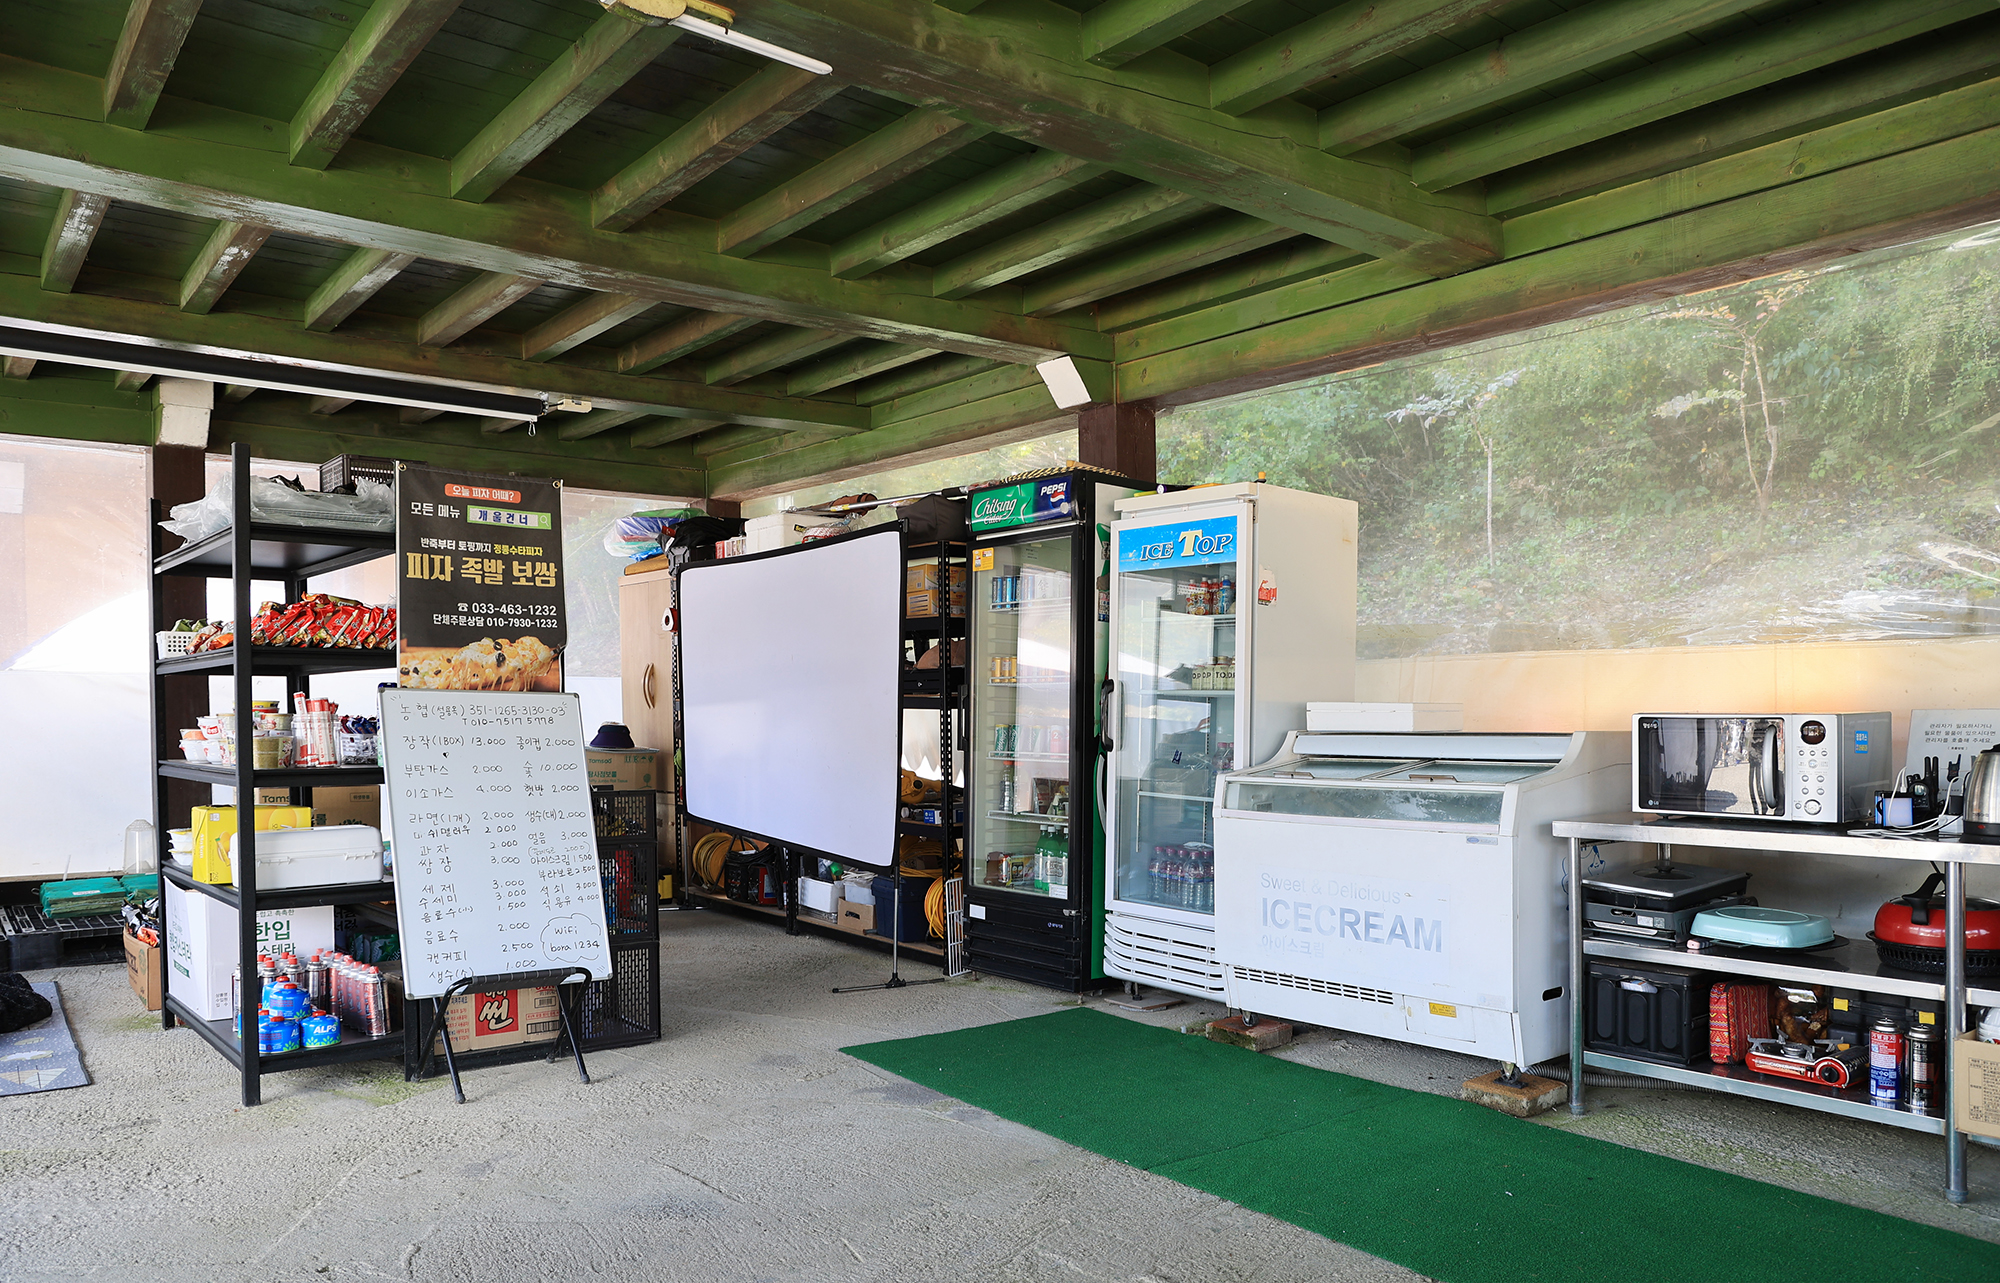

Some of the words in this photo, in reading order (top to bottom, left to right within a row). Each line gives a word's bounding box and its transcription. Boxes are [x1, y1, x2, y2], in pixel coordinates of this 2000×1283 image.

[452, 486, 470, 497] 오늘
[472, 488, 490, 499] 피자
[492, 490, 515, 502] 어때?
[1041, 482, 1067, 496] PEPSI
[411, 502, 434, 517] 모든
[438, 504, 461, 519] 메뉴
[974, 498, 1018, 520] Chilsung
[420, 537, 456, 550] 반죽부터
[458, 540, 492, 553] 토핑까지
[1140, 541, 1174, 561] ICE
[1178, 529, 1233, 557] TOP
[406, 552, 454, 582] 피자
[460, 556, 505, 586] 족발
[511, 560, 558, 588] 보쌈
[471, 603, 557, 616] 033-463-1232
[433, 614, 484, 628] 단체주문상담
[486, 618, 558, 629] 010-7930-1232
[526, 716, 555, 726] 5778
[471, 737, 506, 746] 13.000
[516, 735, 542, 751] 종이컵
[545, 738, 576, 747] 2.000
[404, 765, 450, 778] 부탄가스
[472, 765, 504, 774] 2.000
[540, 763, 578, 772] 10.000
[406, 786, 454, 798] 이소가스
[476, 785, 512, 793] 4.000
[524, 783, 544, 796] 햇반
[552, 785, 580, 793] 2.000
[481, 811, 514, 820] 2.000
[558, 810, 587, 820] 2.000
[528, 832, 546, 845] 얼음
[561, 831, 588, 840] 3.000
[491, 856, 520, 865] 3.000
[531, 854, 571, 865] 아이스크림
[574, 853, 592, 863] 1.500
[575, 865, 596, 874] 2.500
[492, 879, 525, 889] 3.000
[1261, 873, 1306, 893] Sweet
[1328, 880, 1401, 904] Delicious
[419, 893, 457, 909] 수세미
[496, 889, 527, 900] 3.000
[542, 896, 571, 911] 식용유
[577, 894, 599, 903] 4.000
[498, 901, 526, 911] 1.500
[257, 920, 290, 942] 한입
[497, 921, 530, 931] 2.000
[1262, 897, 1442, 953] ICECREAM
[427, 950, 467, 964] 캔커피
[501, 942, 534, 953] 2.500
[550, 943, 571, 953] bora
[574, 940, 600, 949] 1234
[1261, 934, 1325, 959] 아이스크림
[506, 959, 537, 971] 1.000
[313, 1024, 337, 1034] ALPS
